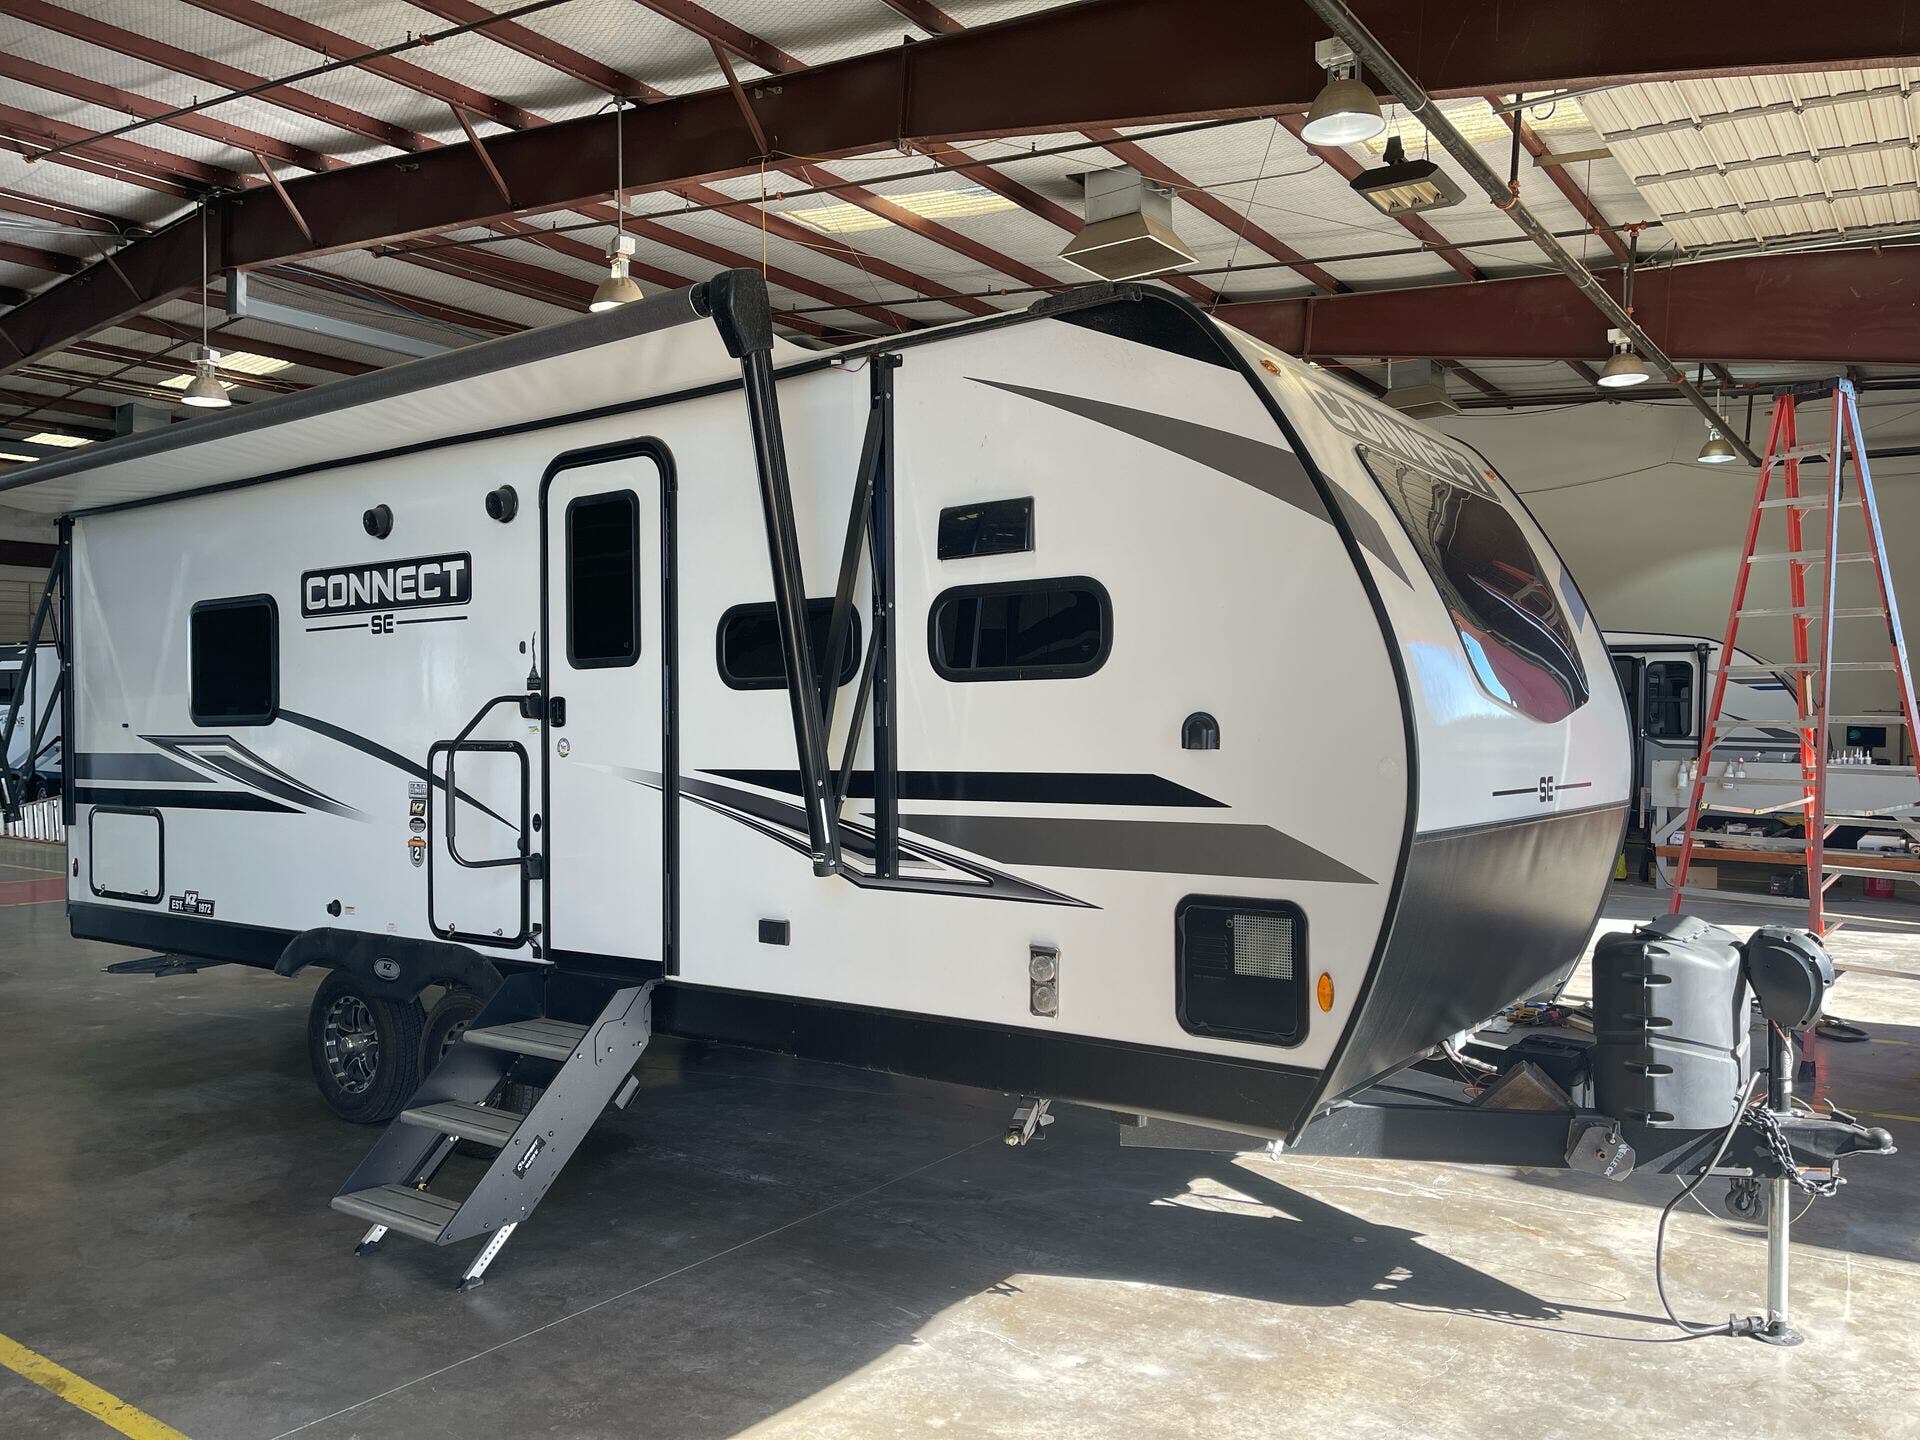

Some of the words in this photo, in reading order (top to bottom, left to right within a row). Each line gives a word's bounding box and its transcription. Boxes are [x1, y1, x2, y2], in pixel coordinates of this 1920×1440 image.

[1306, 382, 1489, 494] CONNECT
[306, 559, 465, 611] CONNECT
[370, 613, 394, 635] SE
[1539, 776, 1553, 802] SE
[414, 846, 420, 859] 2
[171, 900, 184, 910] EST.
[185, 893, 197, 905] KZ
[198, 903, 212, 914] 1972
